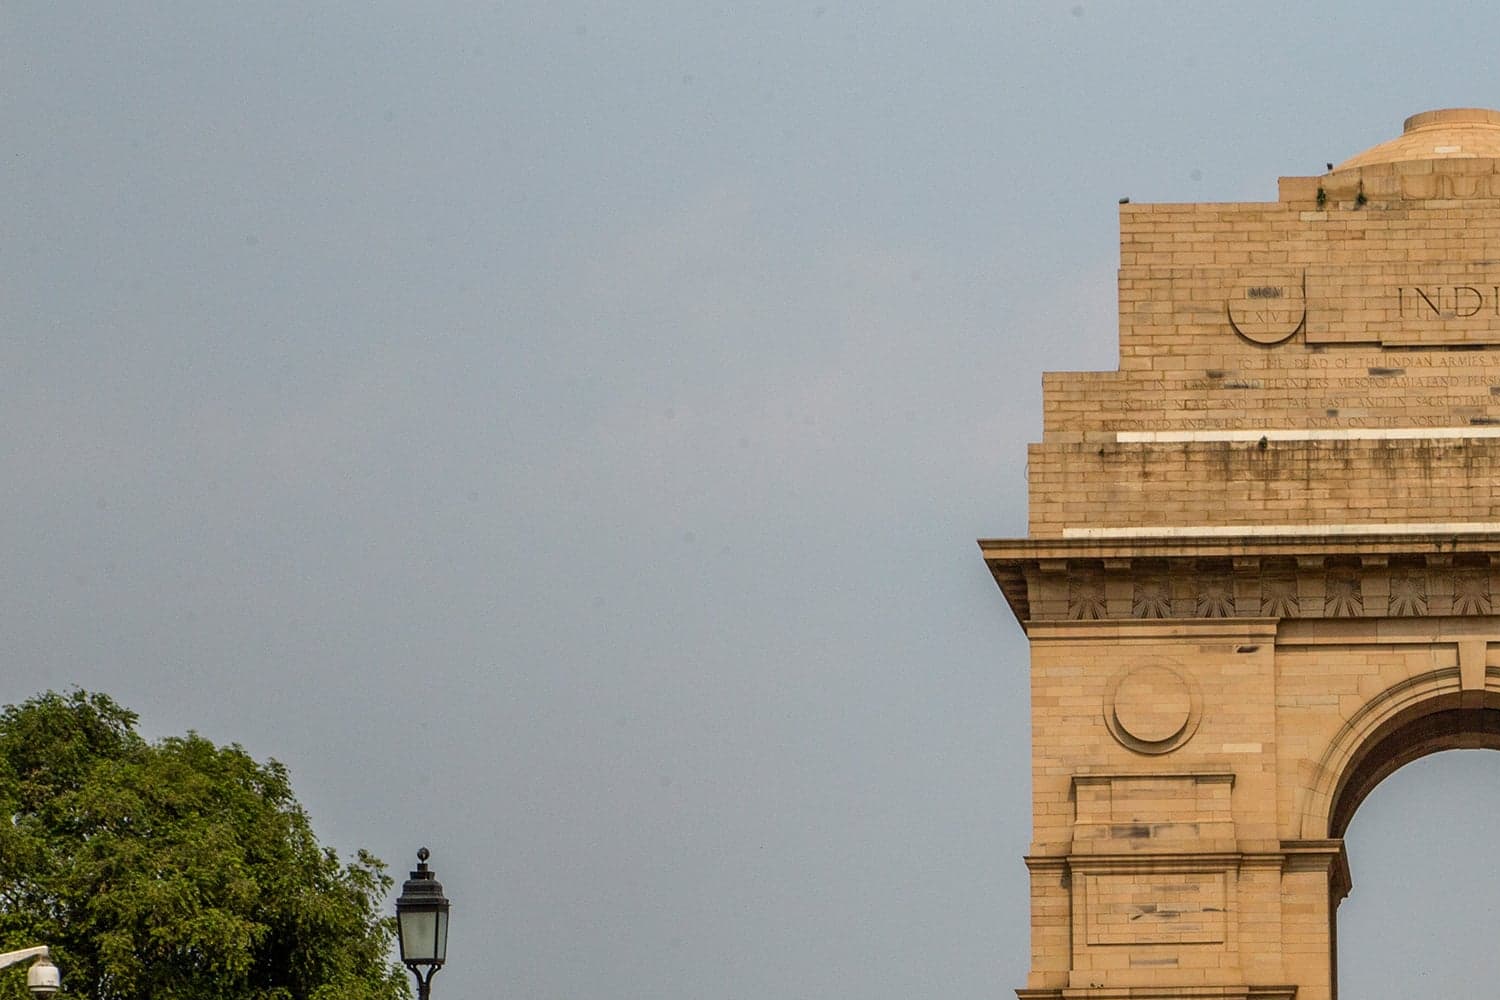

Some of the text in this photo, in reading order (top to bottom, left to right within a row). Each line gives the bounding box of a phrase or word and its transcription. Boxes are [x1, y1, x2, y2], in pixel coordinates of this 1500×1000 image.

[1260, 358, 1283, 369] THE
[1294, 357, 1329, 368] DEAD
[1357, 357, 1380, 367] THE
[1388, 356, 1432, 367] INDIAN
[1440, 355, 1484, 366] ARMIES
[1266, 377, 1329, 388] FLANDERS
[1336, 376, 1424, 387] MESOPOTAMIA
[1305, 416, 1340, 426] INDIA
[1375, 415, 1399, 425] THE
